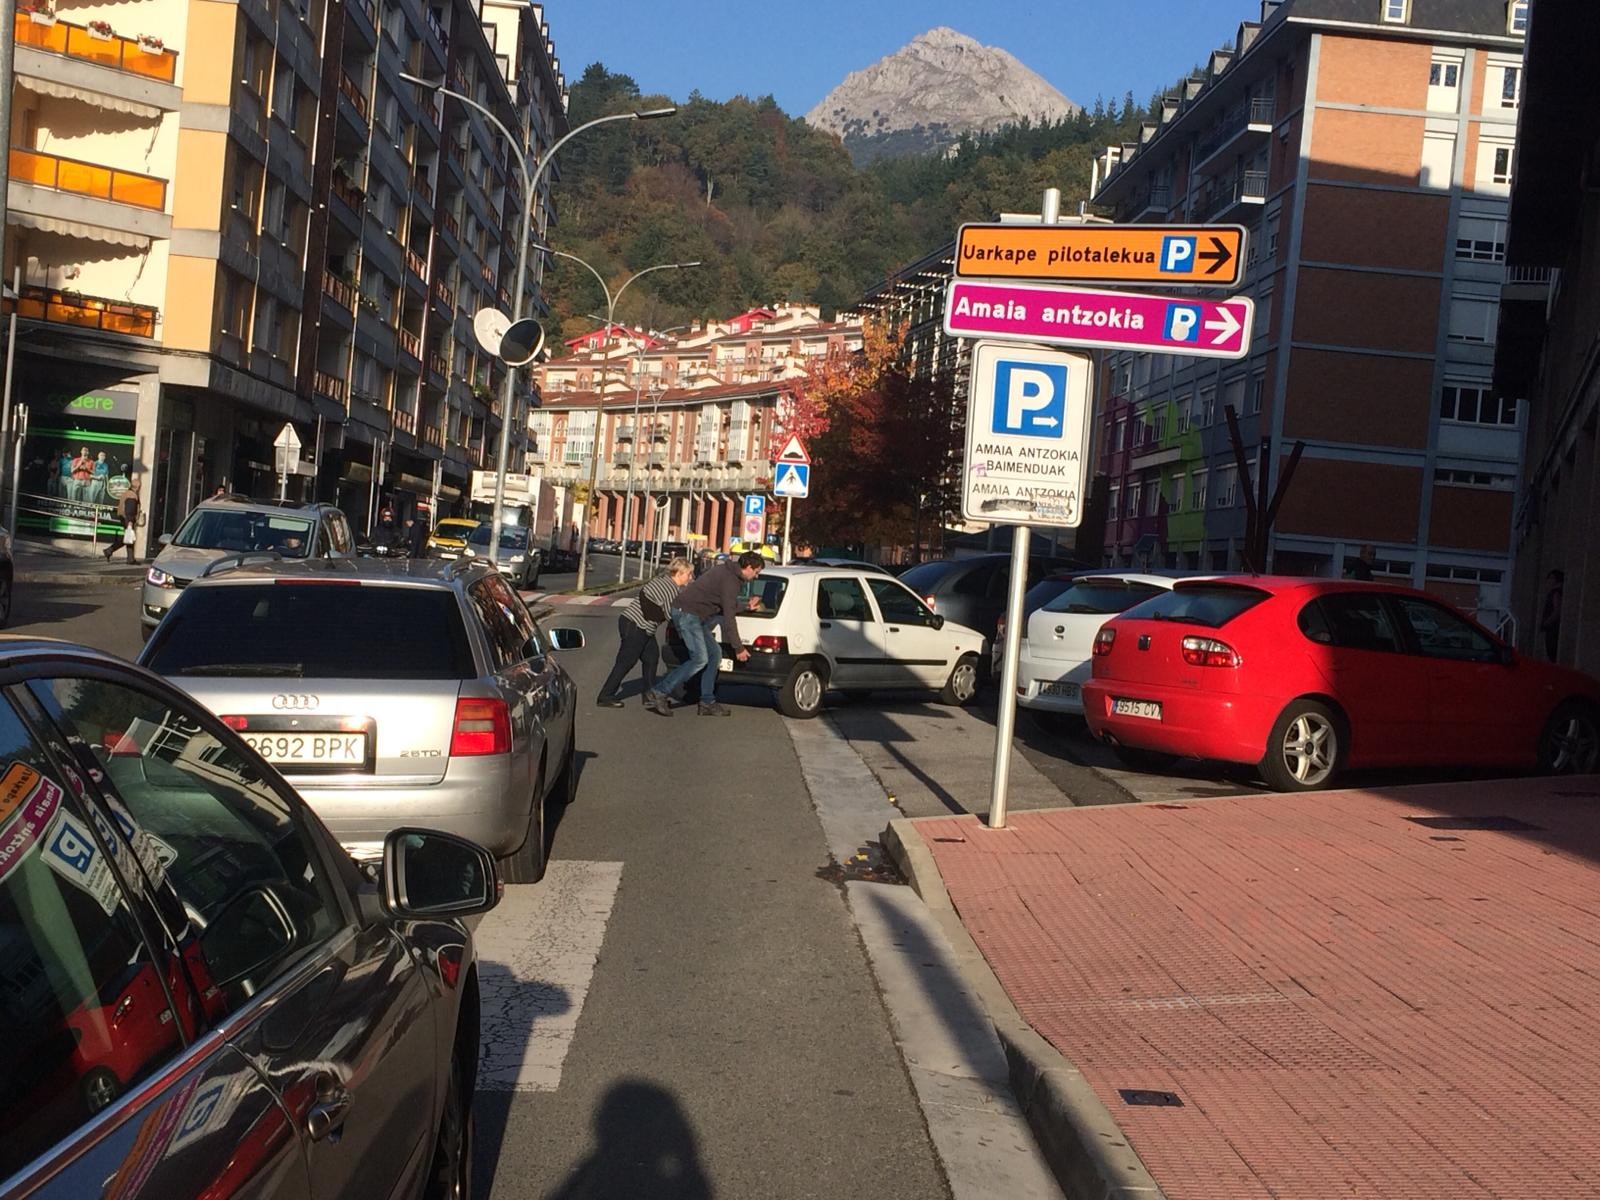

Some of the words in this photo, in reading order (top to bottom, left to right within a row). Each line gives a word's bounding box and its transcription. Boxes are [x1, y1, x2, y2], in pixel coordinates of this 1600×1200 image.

[963, 245, 1037, 265] Uarkape
[1048, 246, 1155, 266] pilotalekua
[1166, 239, 1191, 270] P
[954, 296, 1026, 320] Amaia
[1042, 304, 1144, 330] antzokia
[1171, 307, 1197, 341] P
[1006, 368, 1055, 429] P
[975, 443, 1013, 456] AMAIA
[1019, 447, 1079, 461] ANTZOKIA
[986, 460, 1065, 476] BAIMENDUAK
[972, 483, 1010, 496] AMAIA
[1016, 487, 1076, 501] ANTZOKIA
[749, 498, 761, 513] P
[313, 738, 356, 759] BPK
